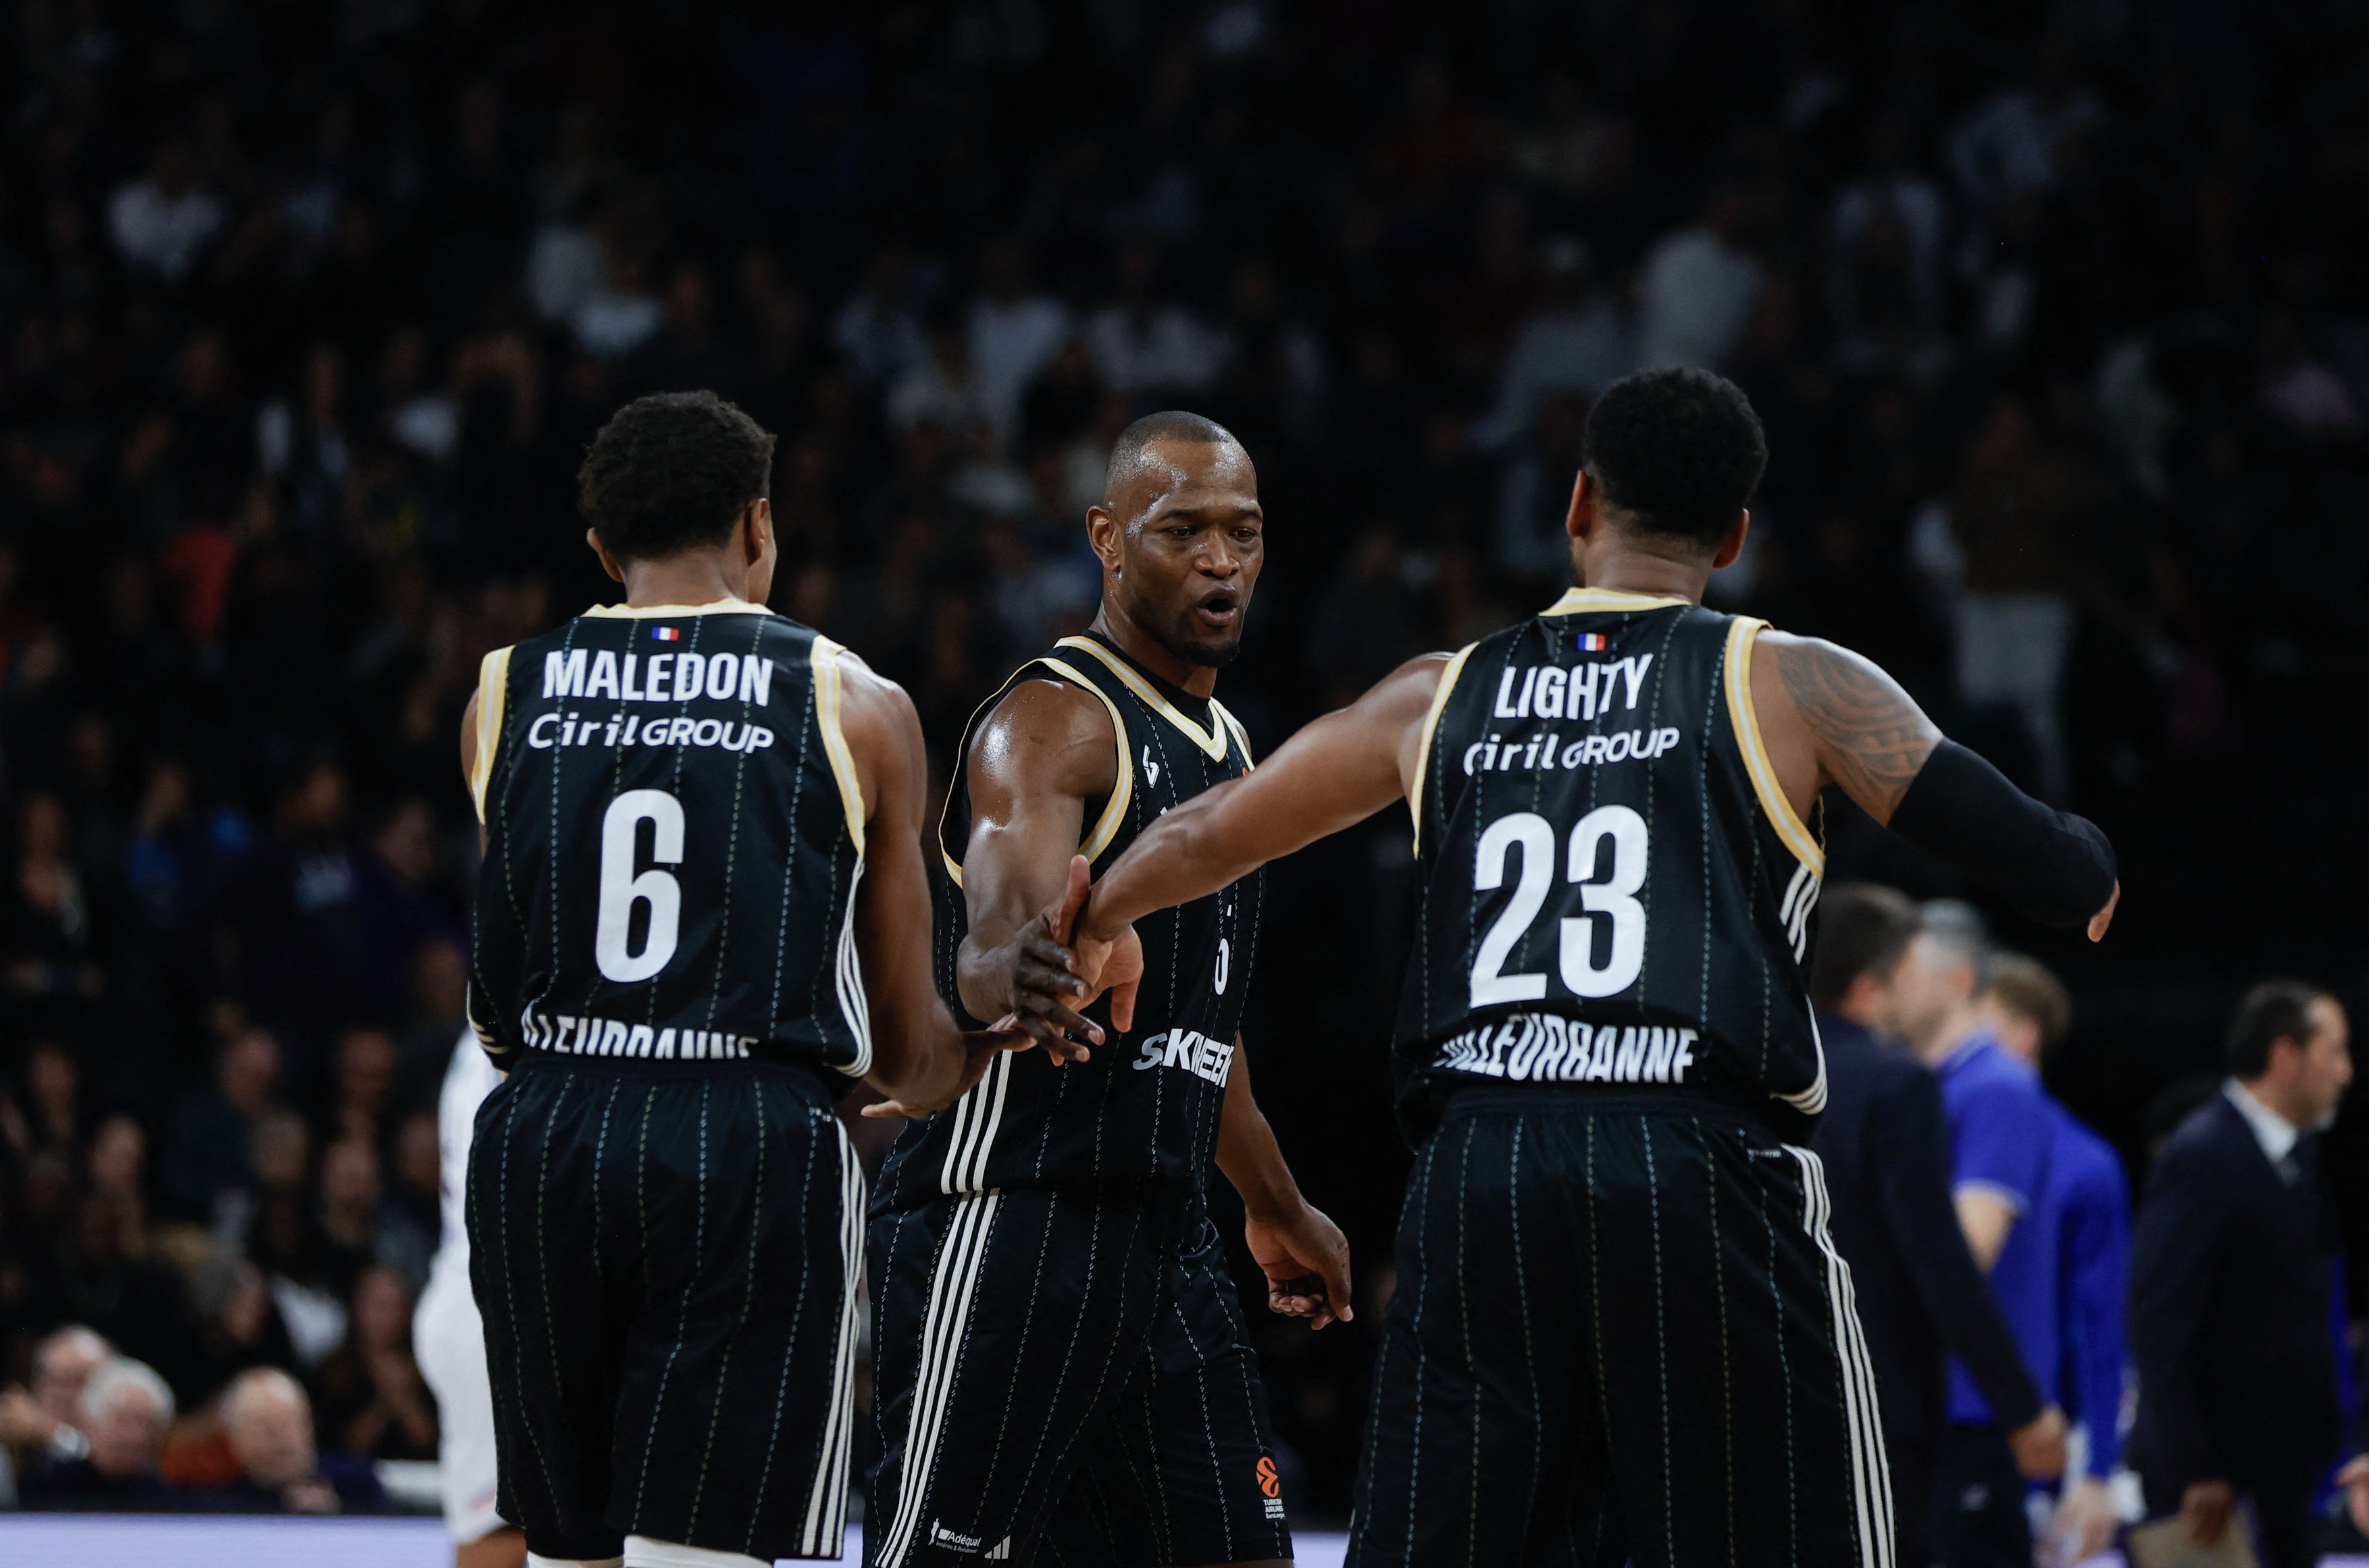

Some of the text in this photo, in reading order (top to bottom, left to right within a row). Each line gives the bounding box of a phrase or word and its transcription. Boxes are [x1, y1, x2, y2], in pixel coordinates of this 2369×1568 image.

[542, 649, 773, 707] MALEDON
[1494, 653, 1654, 721] LIGHTY
[595, 789, 685, 983] 6
[1469, 805, 1649, 1009] 23
[947, 1532, 982, 1547] Adéquat
